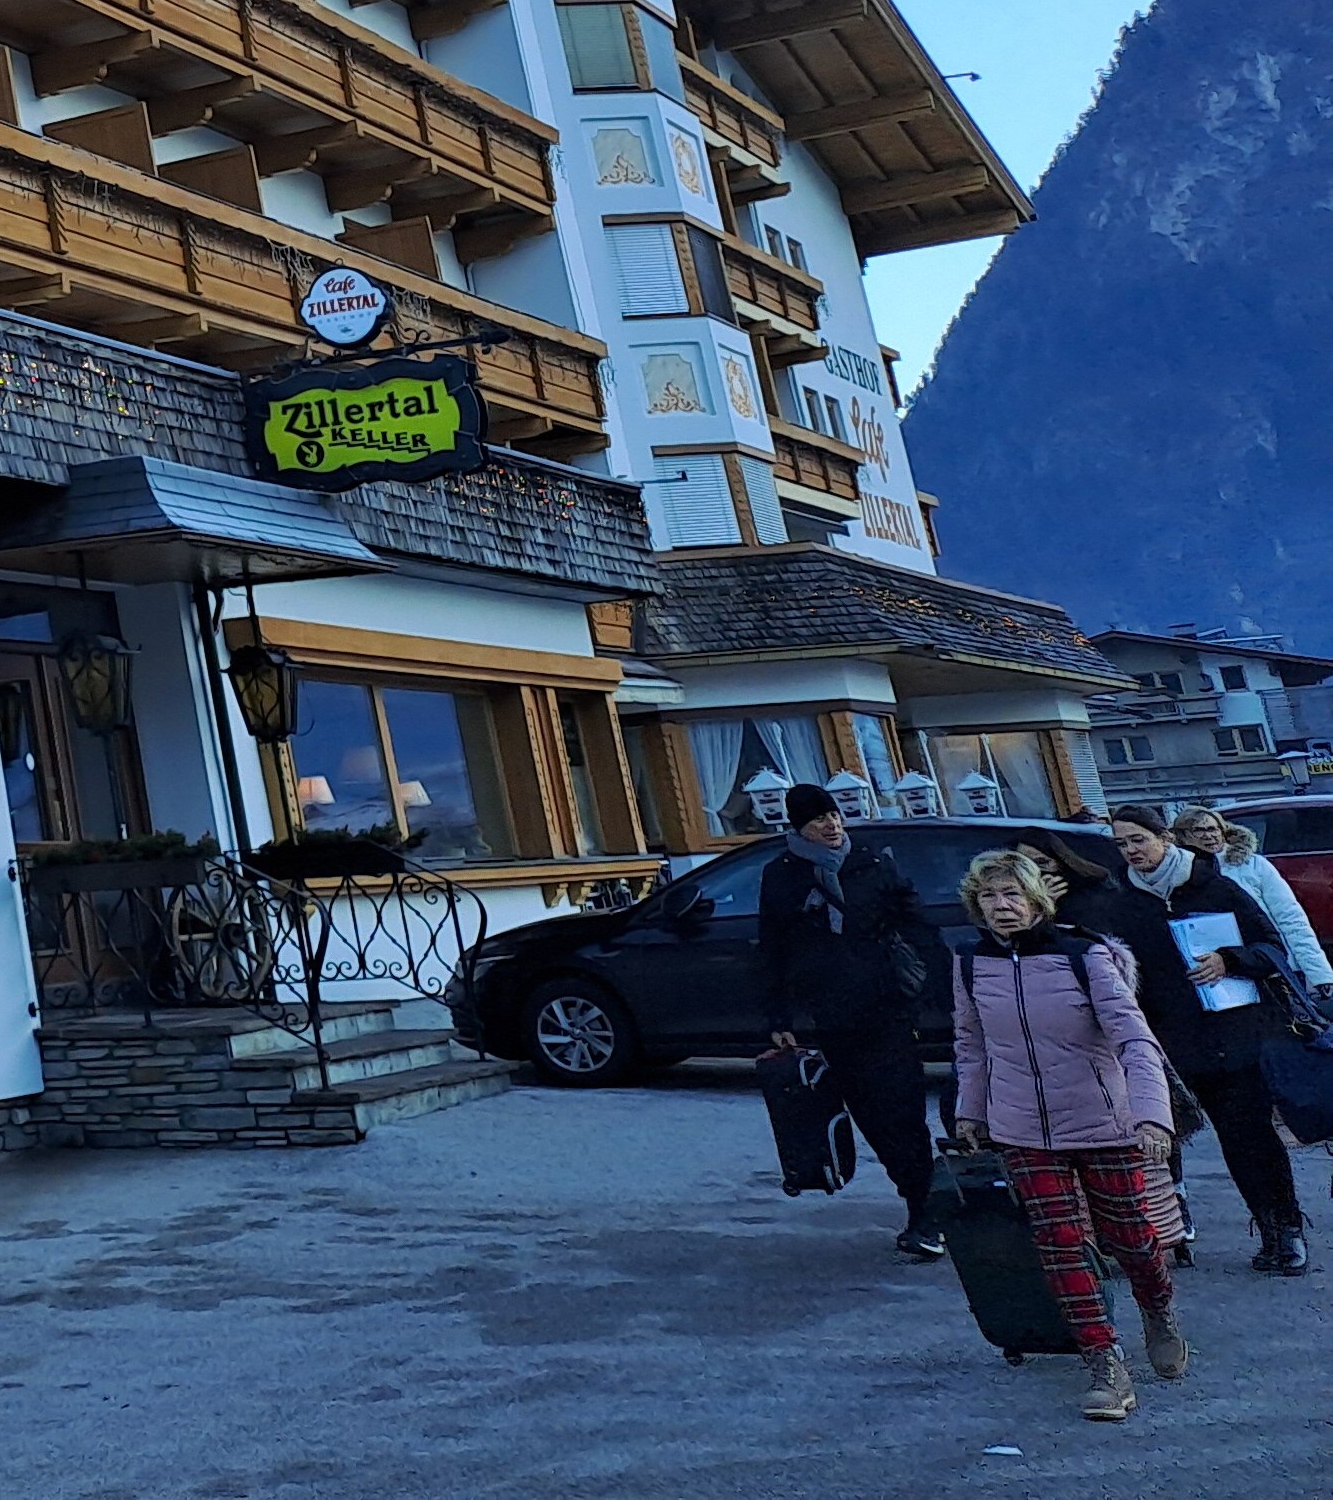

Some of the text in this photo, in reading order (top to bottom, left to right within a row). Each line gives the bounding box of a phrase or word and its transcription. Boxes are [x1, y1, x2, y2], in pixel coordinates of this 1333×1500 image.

[323, 275, 356, 295] Cafe
[307, 293, 380, 319] ZILLERTAL
[281, 384, 440, 439] Zillertal
[330, 426, 431, 448] KELLER
